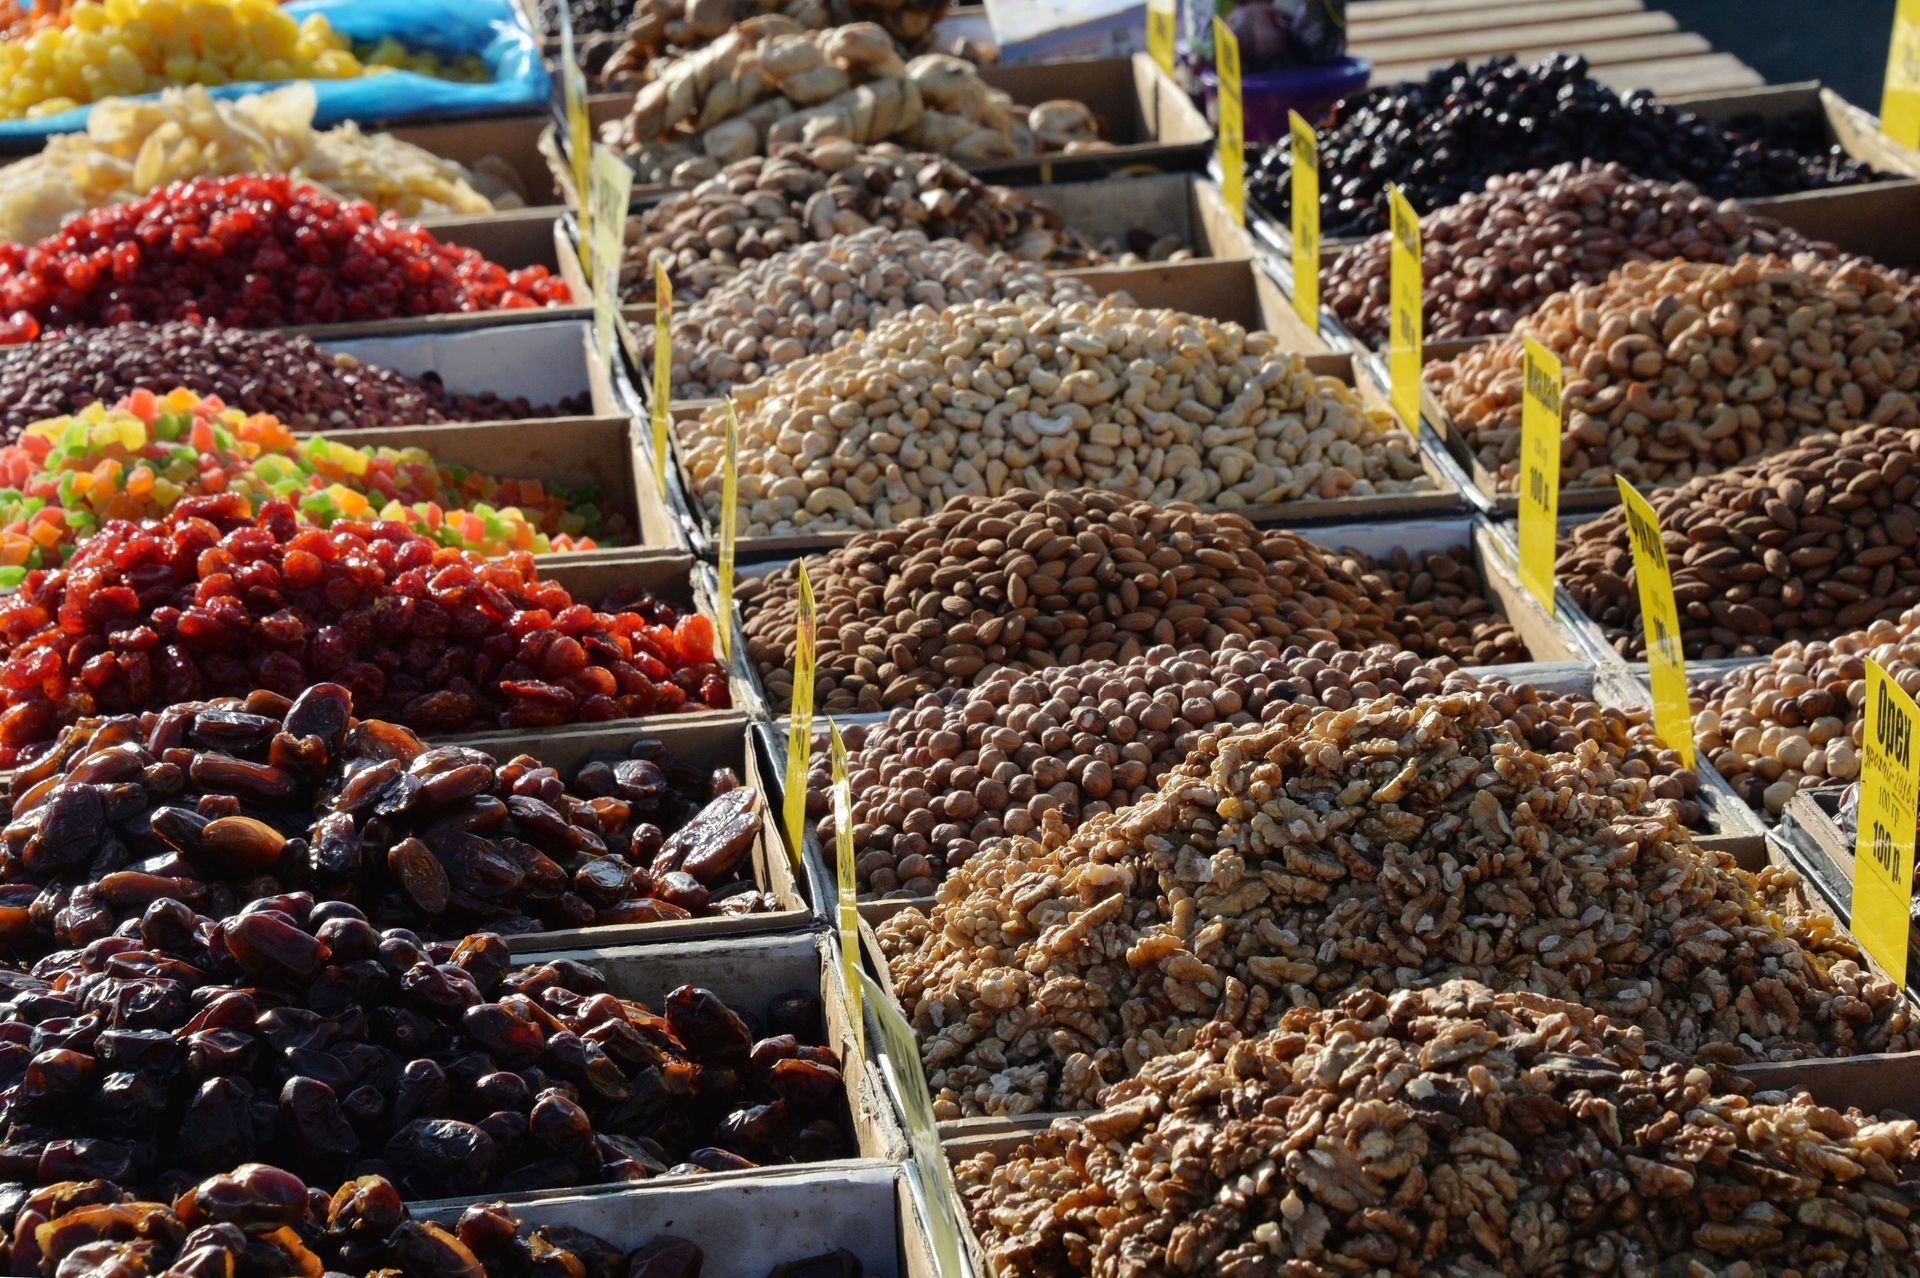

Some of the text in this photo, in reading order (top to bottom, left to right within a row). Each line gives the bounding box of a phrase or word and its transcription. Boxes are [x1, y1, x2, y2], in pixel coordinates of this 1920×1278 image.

[1877, 678, 1912, 772] Орех
[1878, 786, 1891, 813] 100
[1873, 819, 1891, 872] 100
